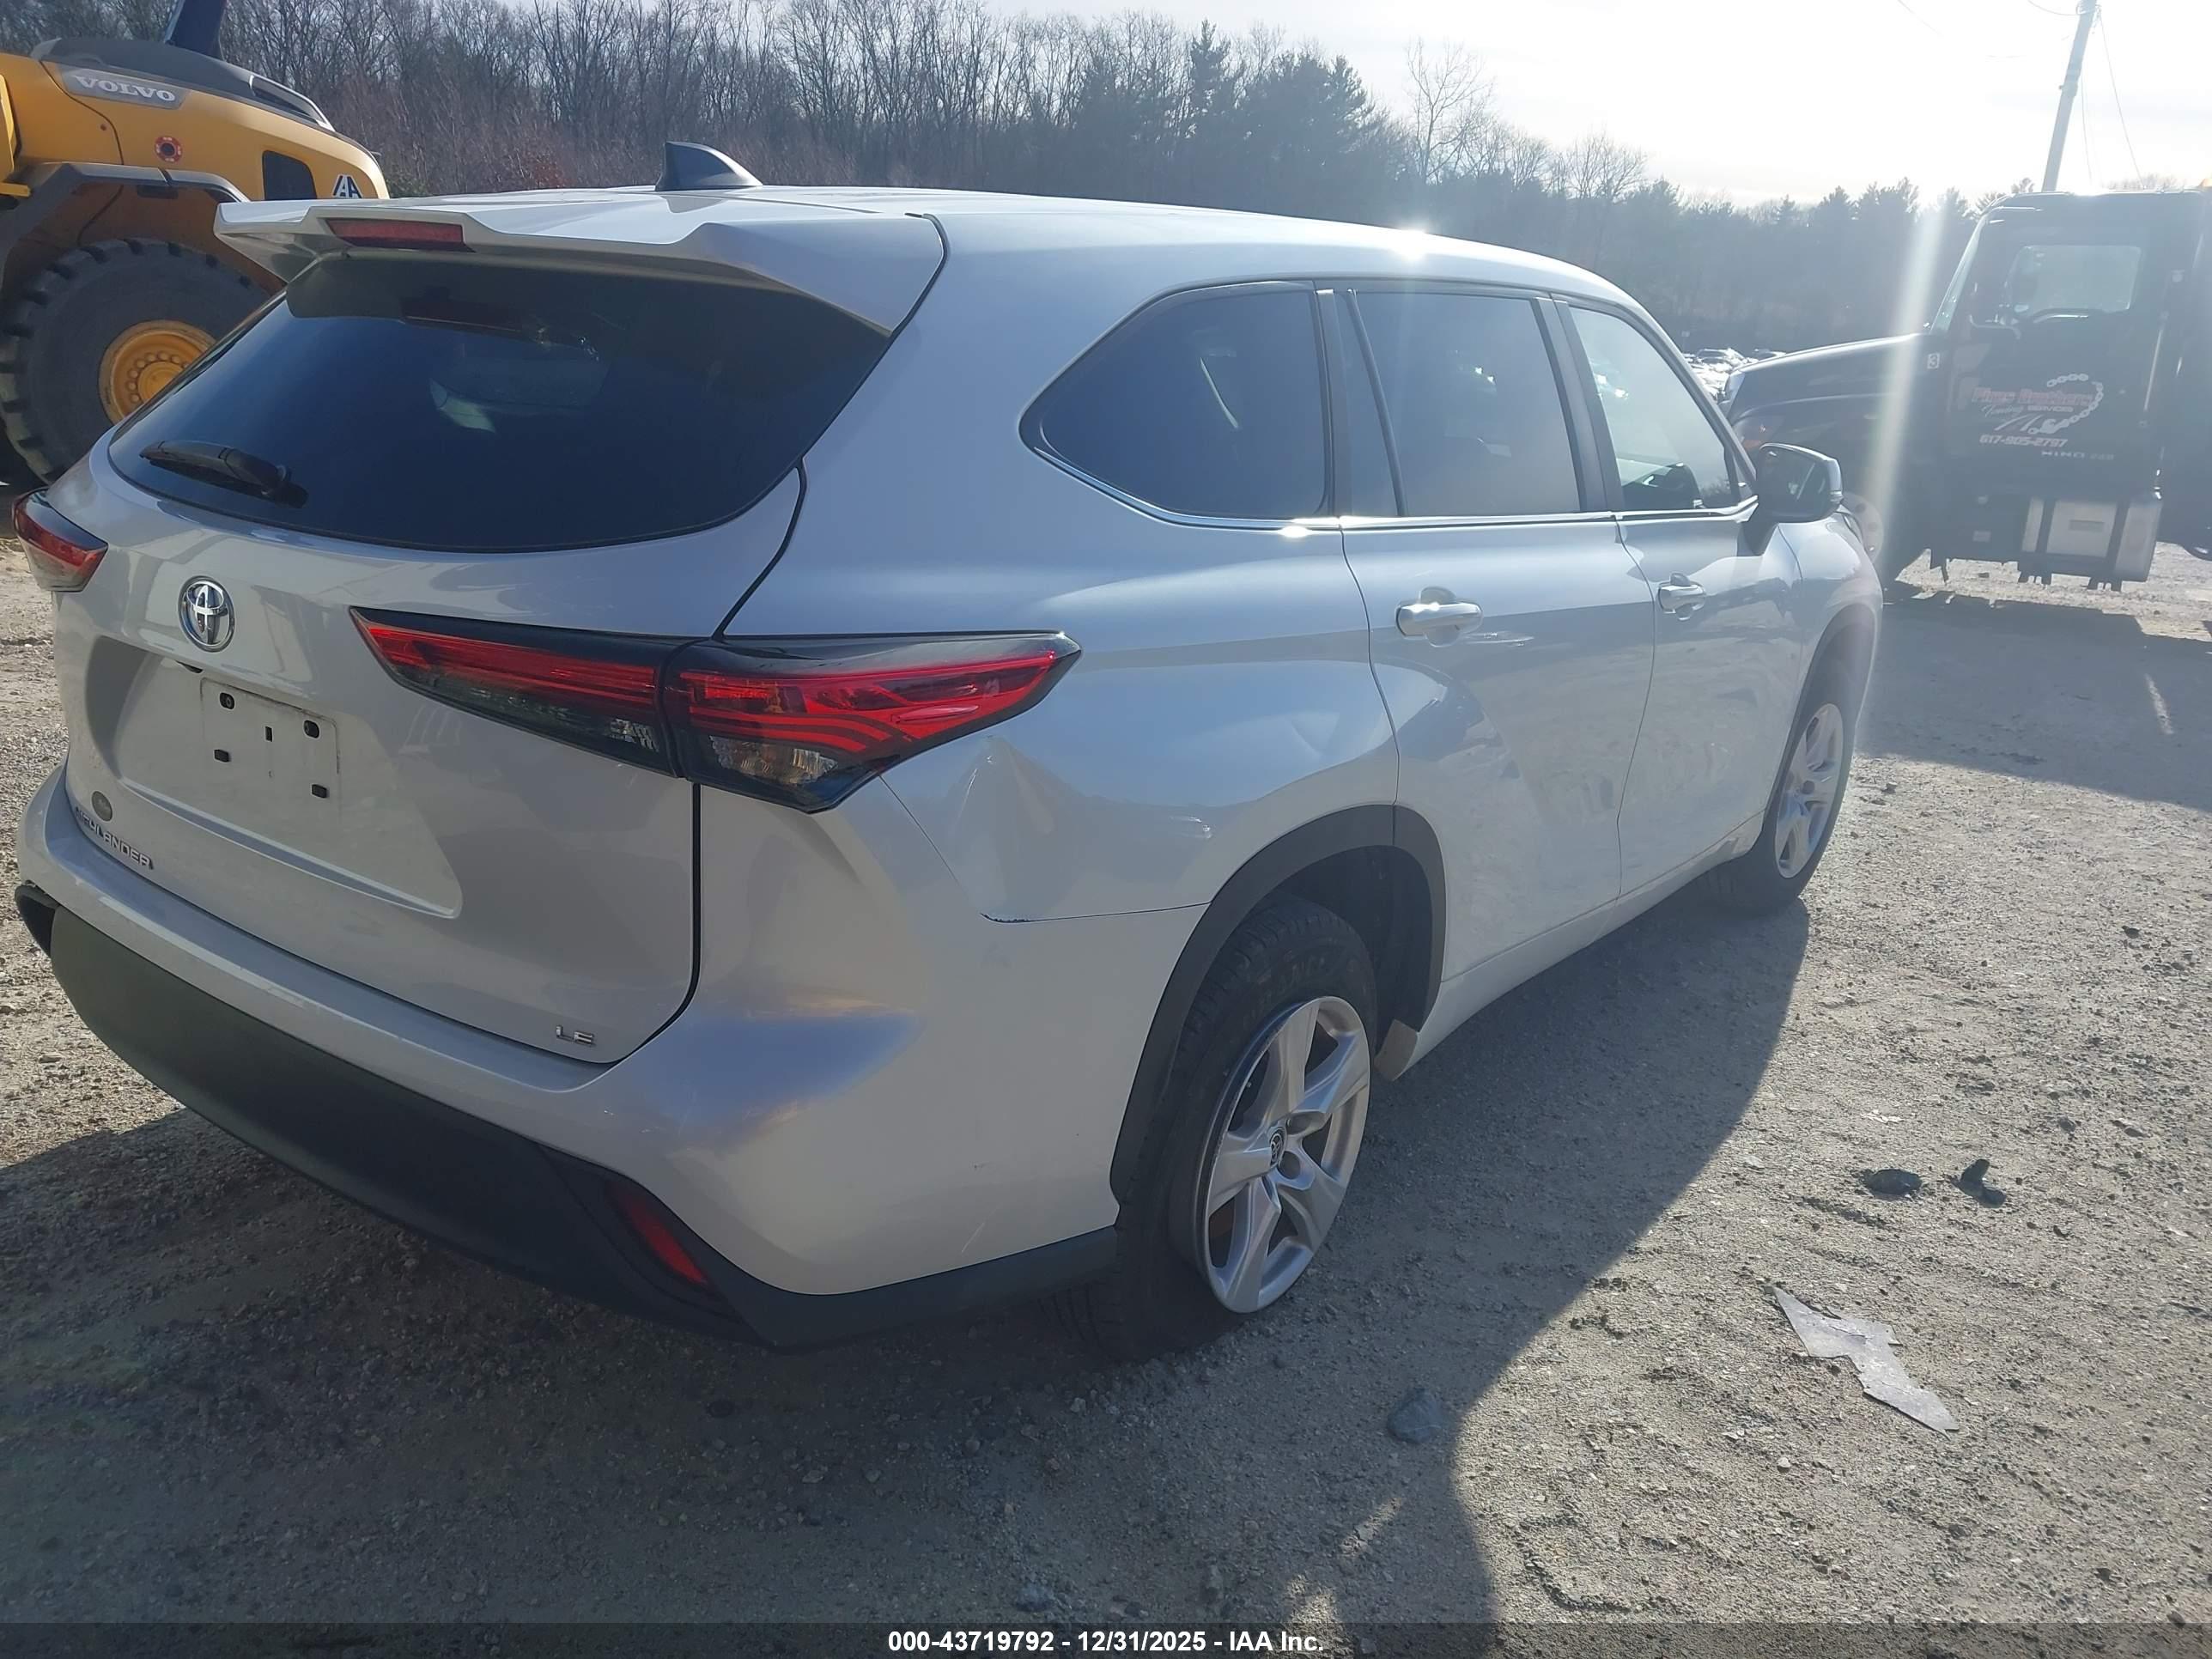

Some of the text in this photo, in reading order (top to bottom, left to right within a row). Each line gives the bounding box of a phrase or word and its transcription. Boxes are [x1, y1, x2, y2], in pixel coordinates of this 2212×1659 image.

[72, 75, 176, 101] VOLVO
[2041, 450, 2085, 459] HINO
[556, 1025, 596, 1046] LE
